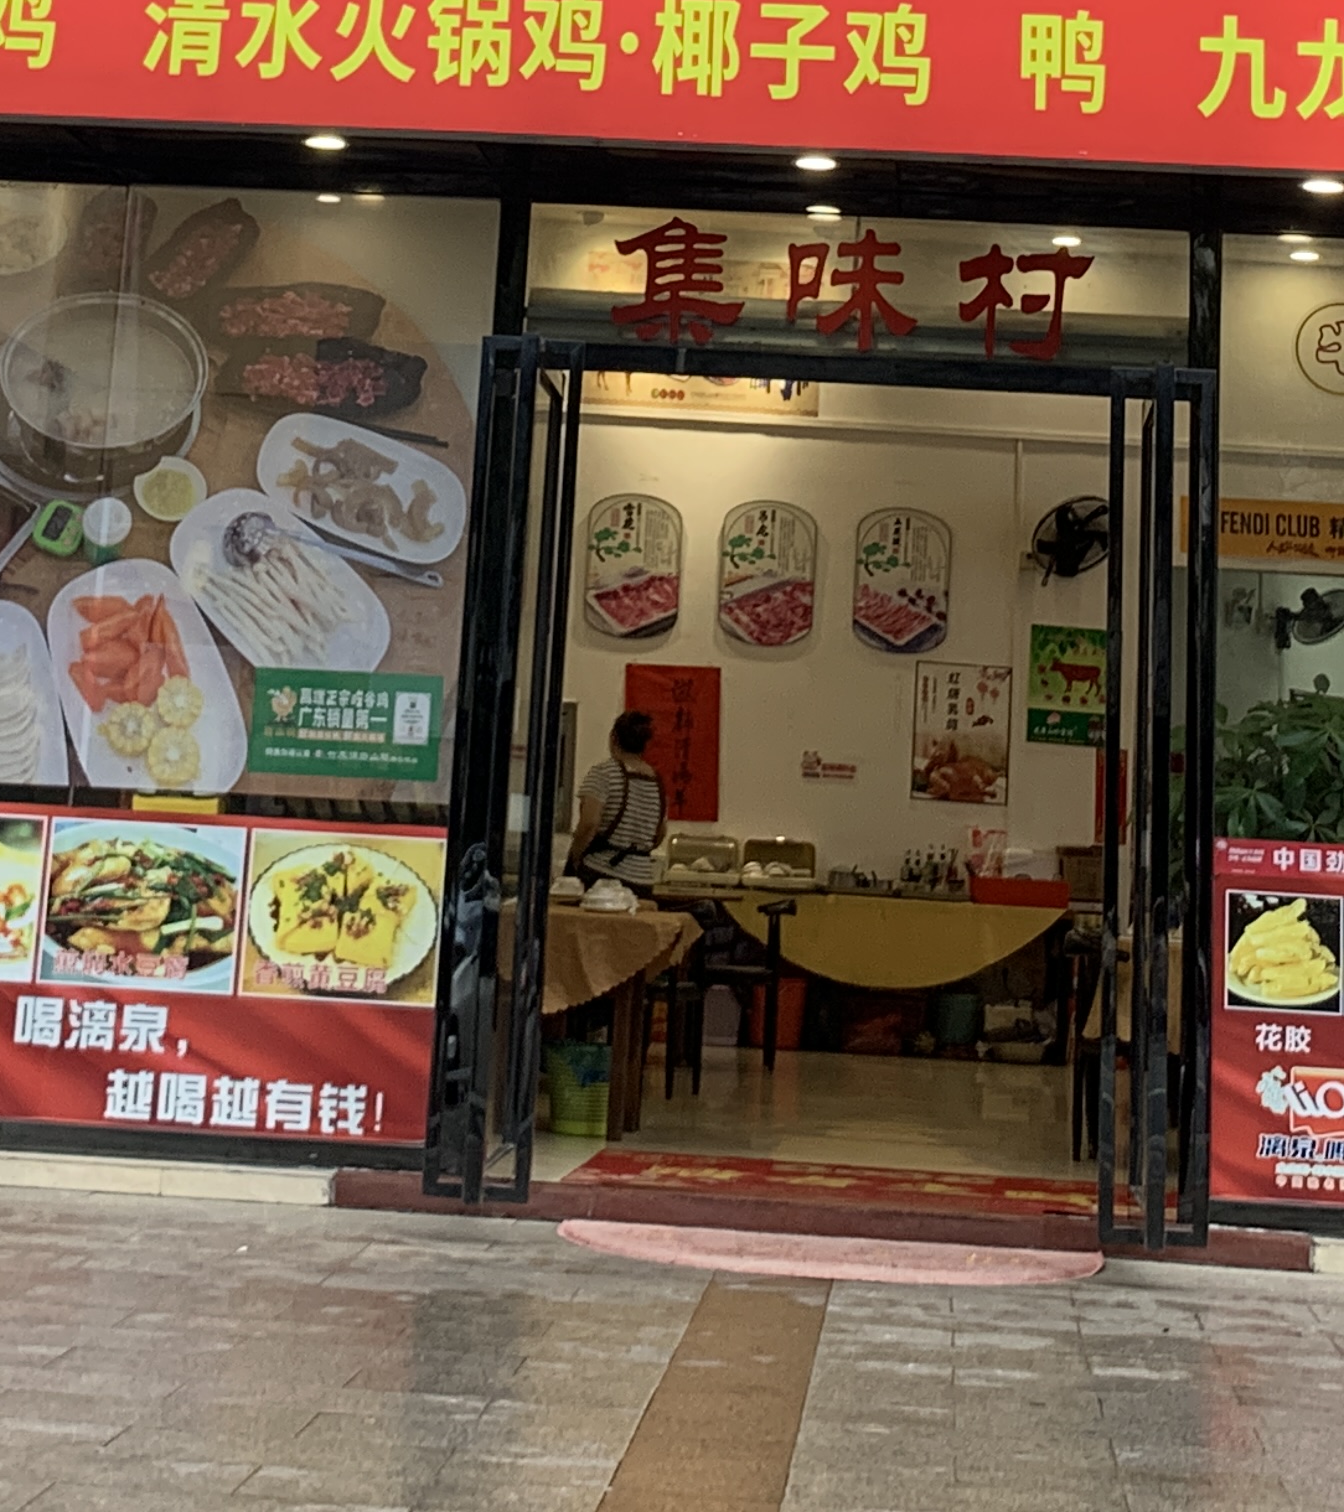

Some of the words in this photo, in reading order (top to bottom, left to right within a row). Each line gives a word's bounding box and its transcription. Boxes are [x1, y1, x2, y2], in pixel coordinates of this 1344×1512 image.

[1020, 9, 1105, 114] 鸭
[611, 217, 1095, 361] 集味村
[1221, 510, 1270, 536] FENDI
[1275, 513, 1321, 538] CLUB
[1255, 1023, 1312, 1054] 花胶
